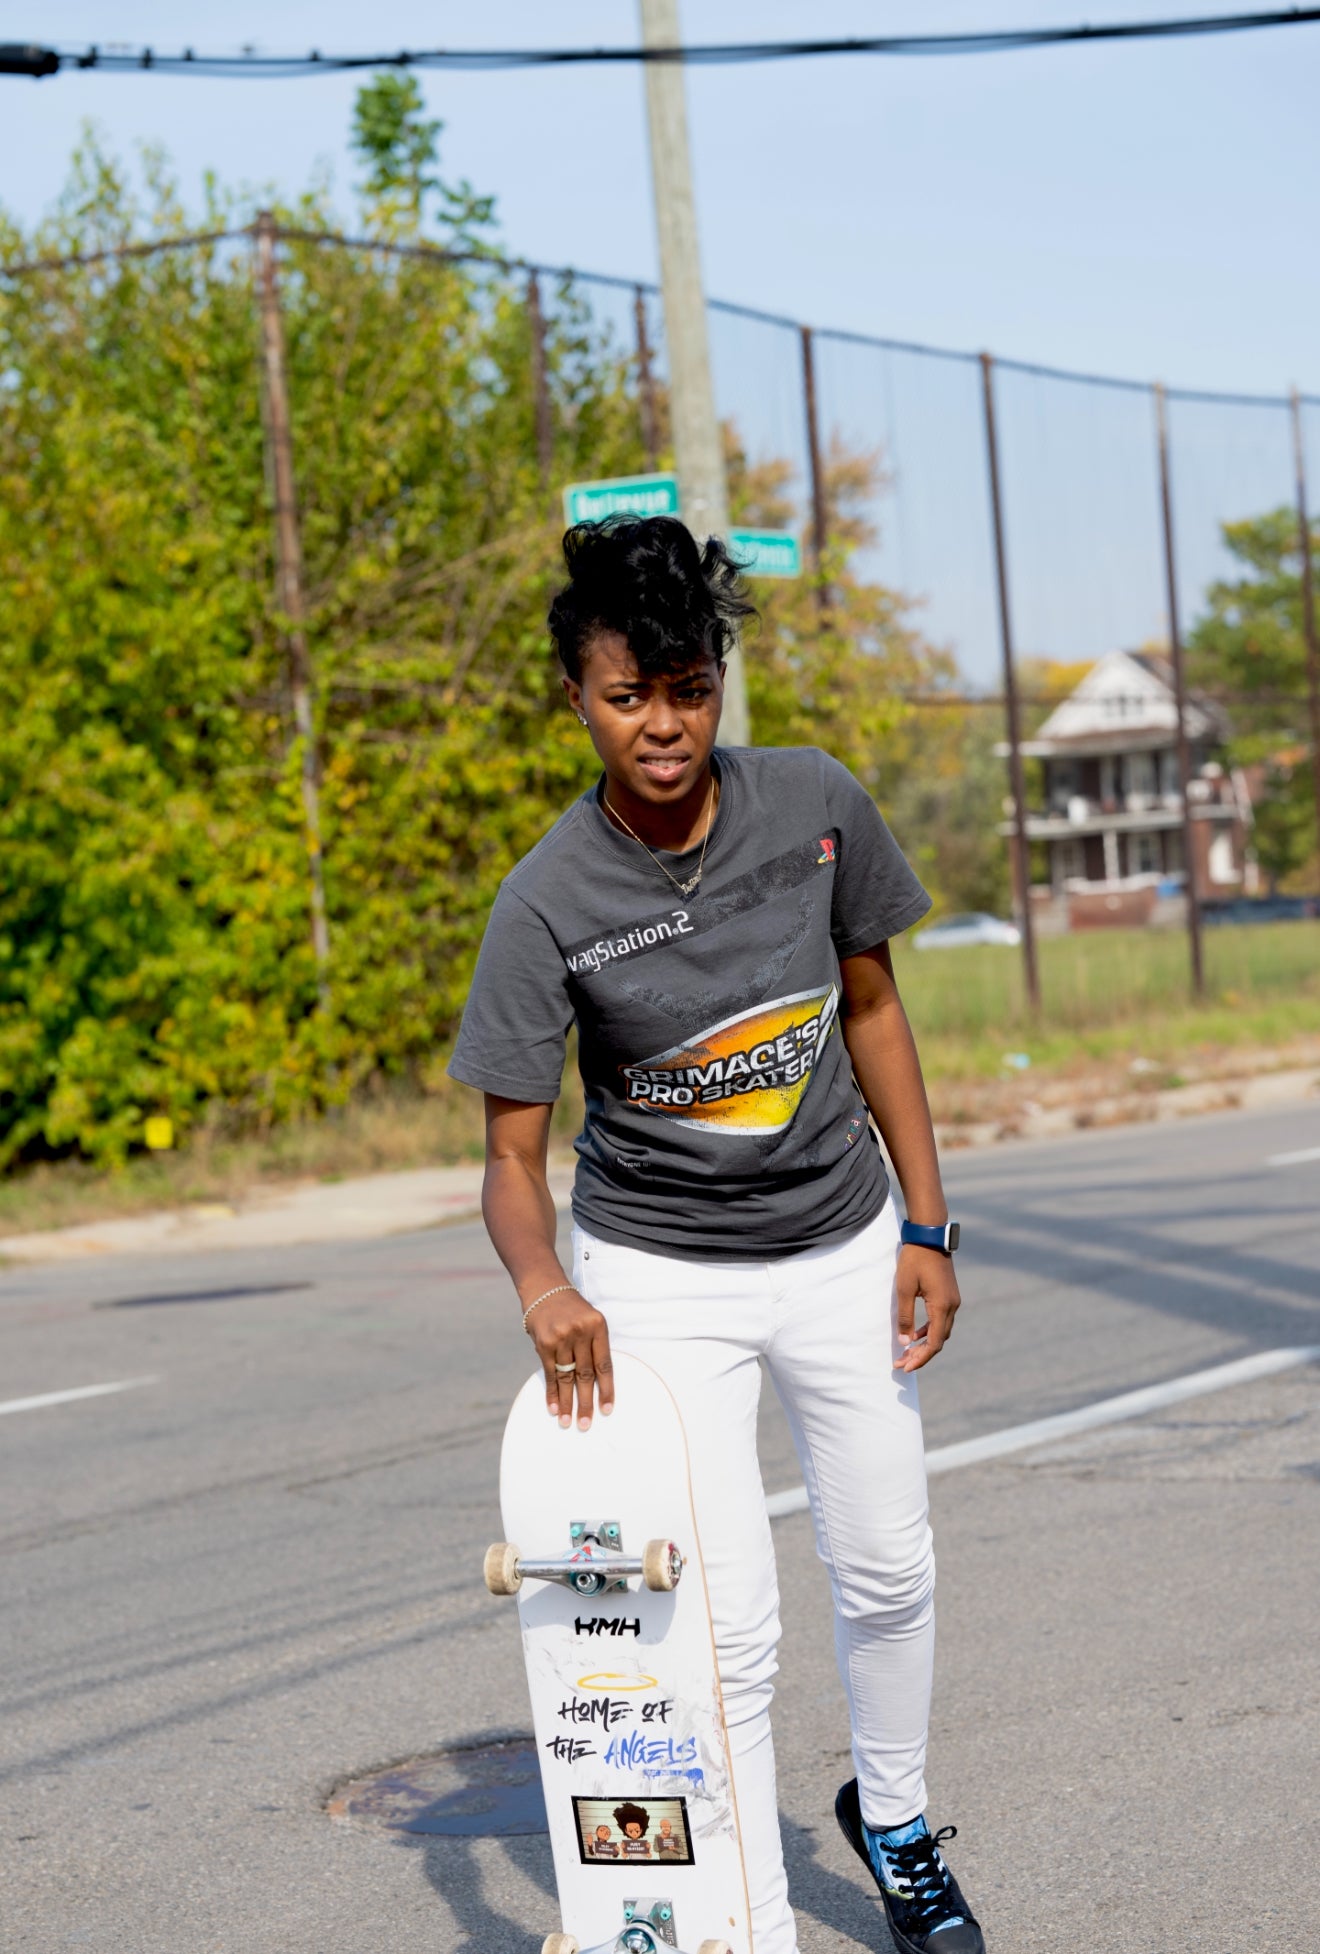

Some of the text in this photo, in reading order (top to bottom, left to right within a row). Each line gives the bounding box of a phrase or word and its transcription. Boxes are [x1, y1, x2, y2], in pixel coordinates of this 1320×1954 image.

[622, 1018, 819, 1087] GRIMACE'S
[630, 1048, 814, 1105] PRO SKATER
[557, 1696, 675, 1733] HOME OF
[545, 1729, 698, 1771] THE ANGELS
